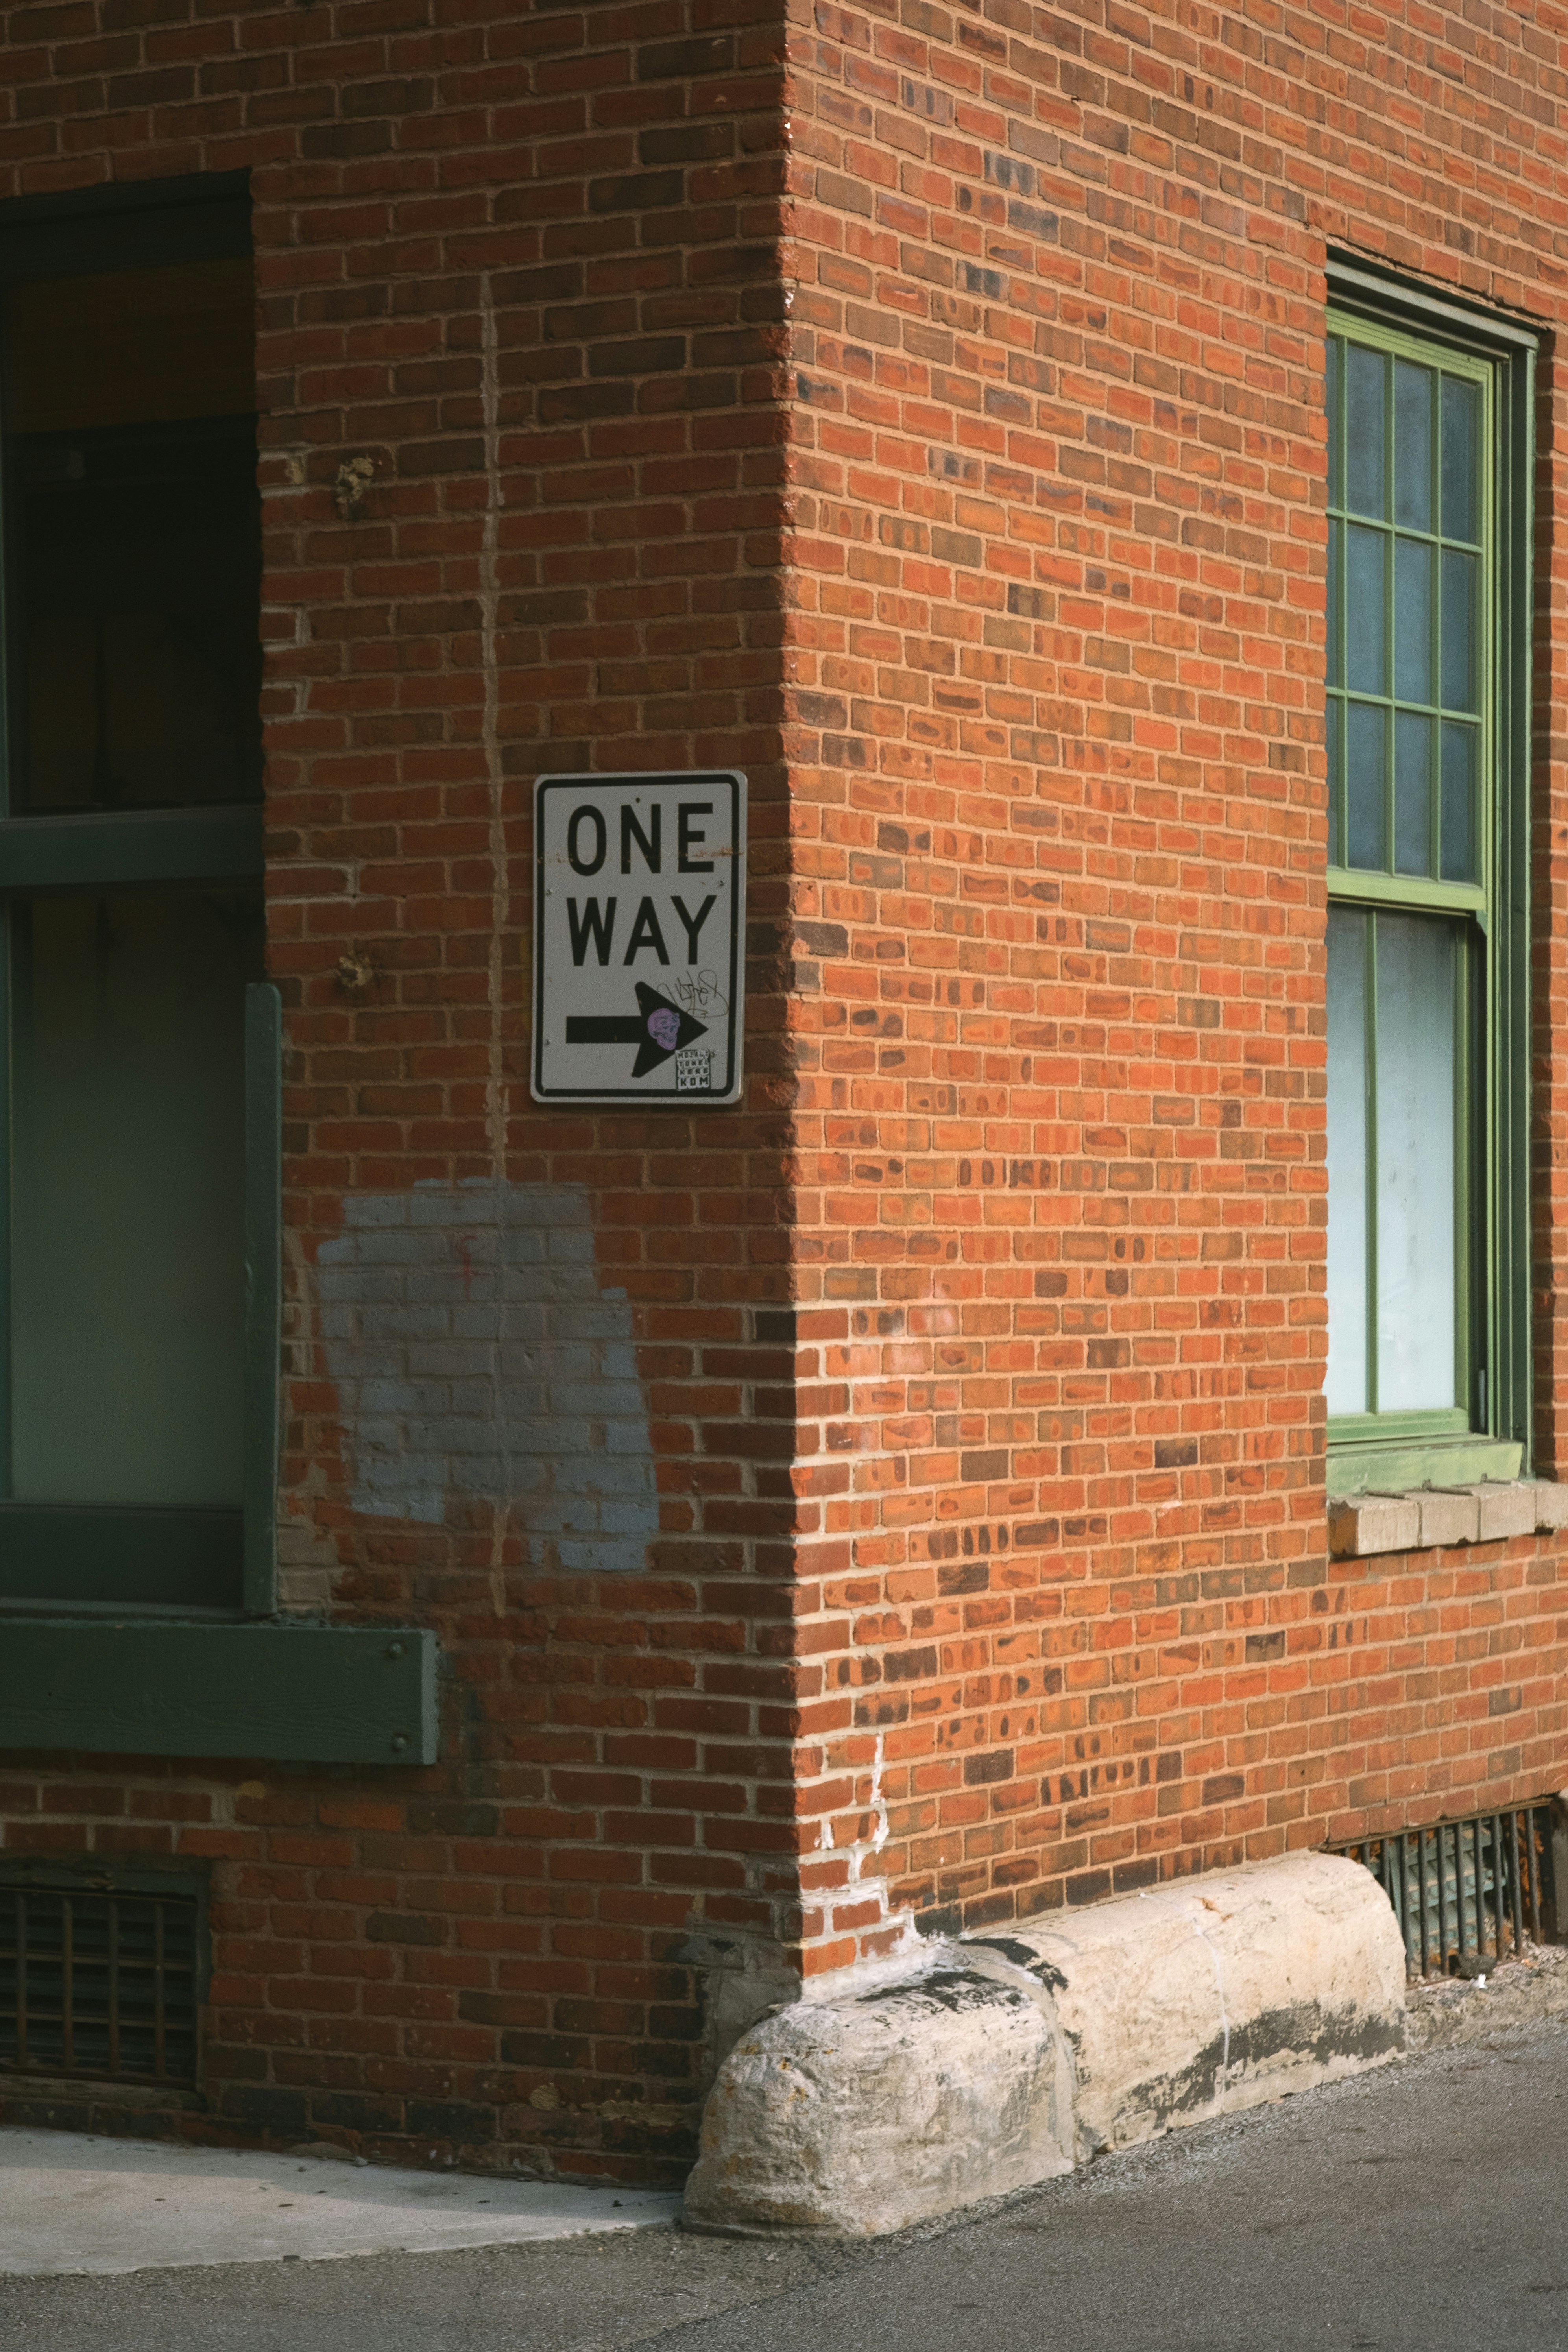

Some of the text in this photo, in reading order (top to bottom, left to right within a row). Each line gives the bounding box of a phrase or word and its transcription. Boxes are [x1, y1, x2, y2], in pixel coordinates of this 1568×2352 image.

[567, 802, 715, 877] ONE
[566, 895, 718, 967] WAY
[680, 1076, 708, 1086] KOM
